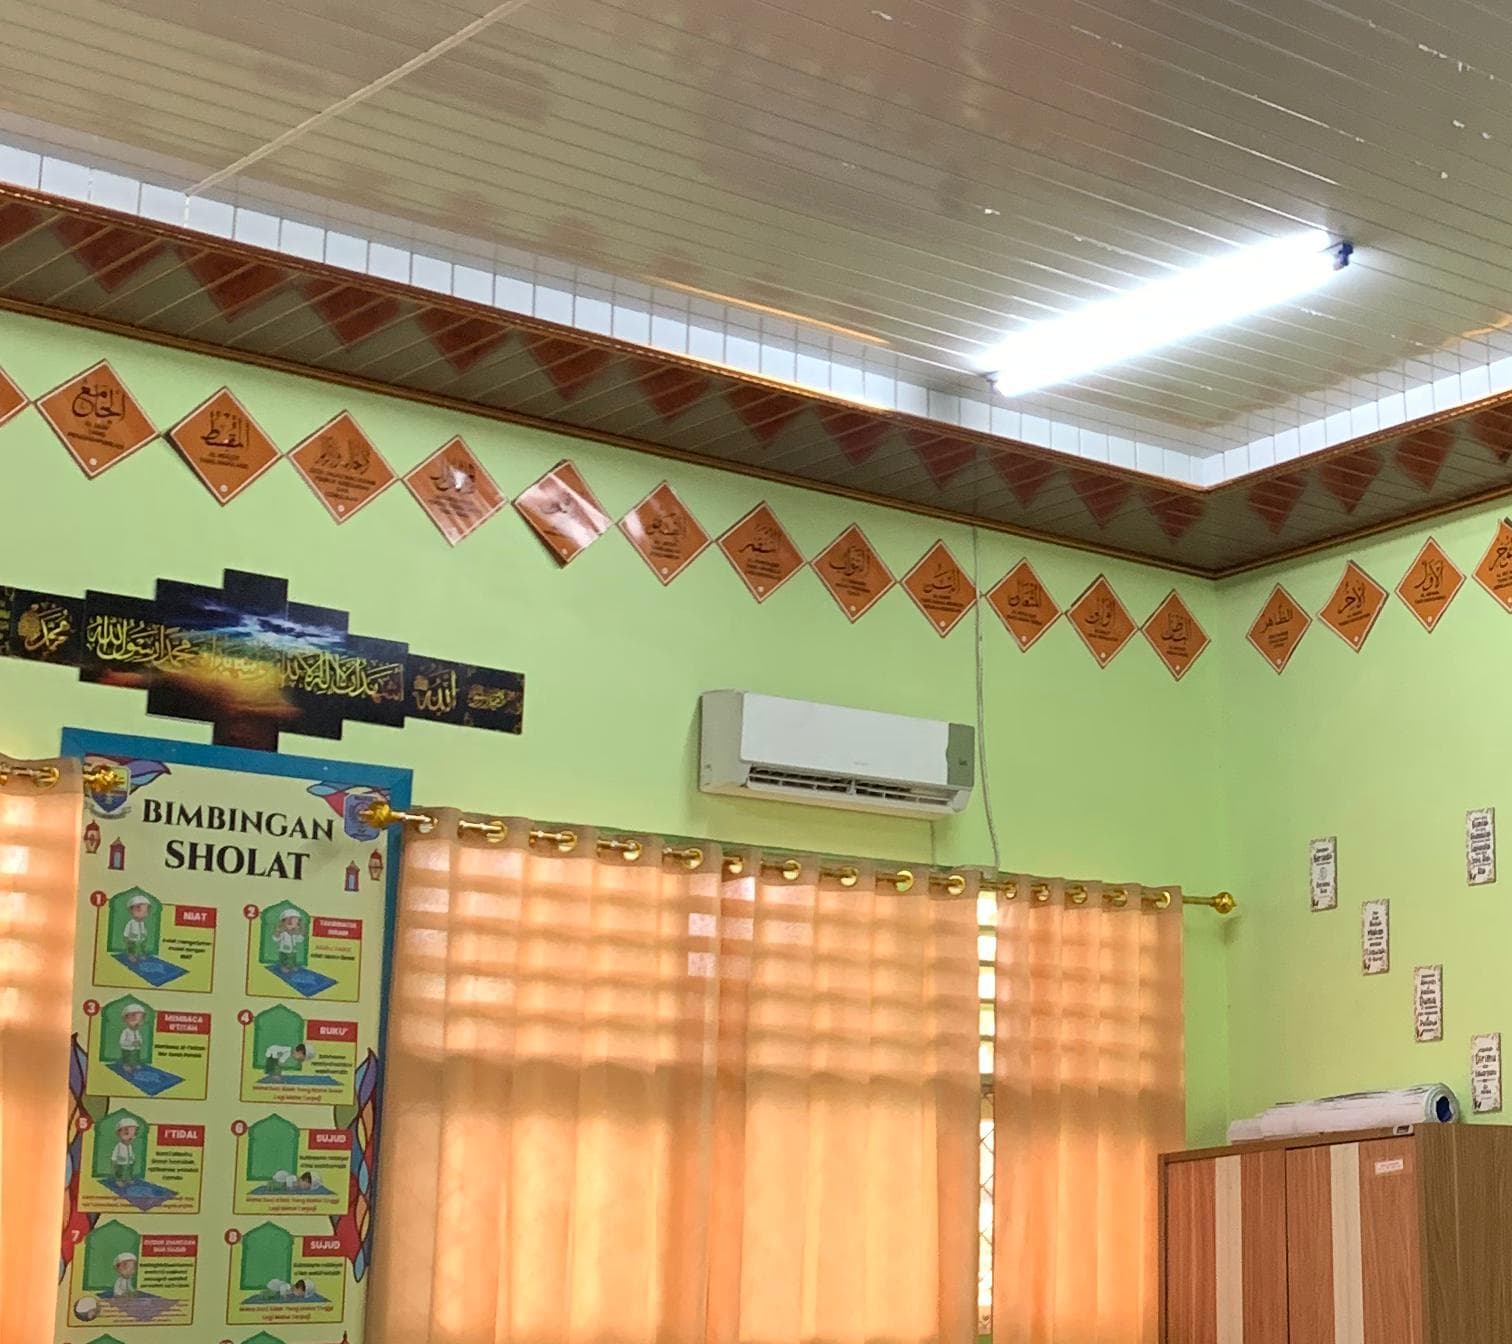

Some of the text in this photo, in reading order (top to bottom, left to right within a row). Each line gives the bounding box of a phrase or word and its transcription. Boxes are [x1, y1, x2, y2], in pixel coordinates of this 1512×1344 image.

[142, 799, 334, 841] BIMBINGAN
[164, 839, 310, 880] SHOLAT
[310, 1240, 341, 1250] SUJUD
